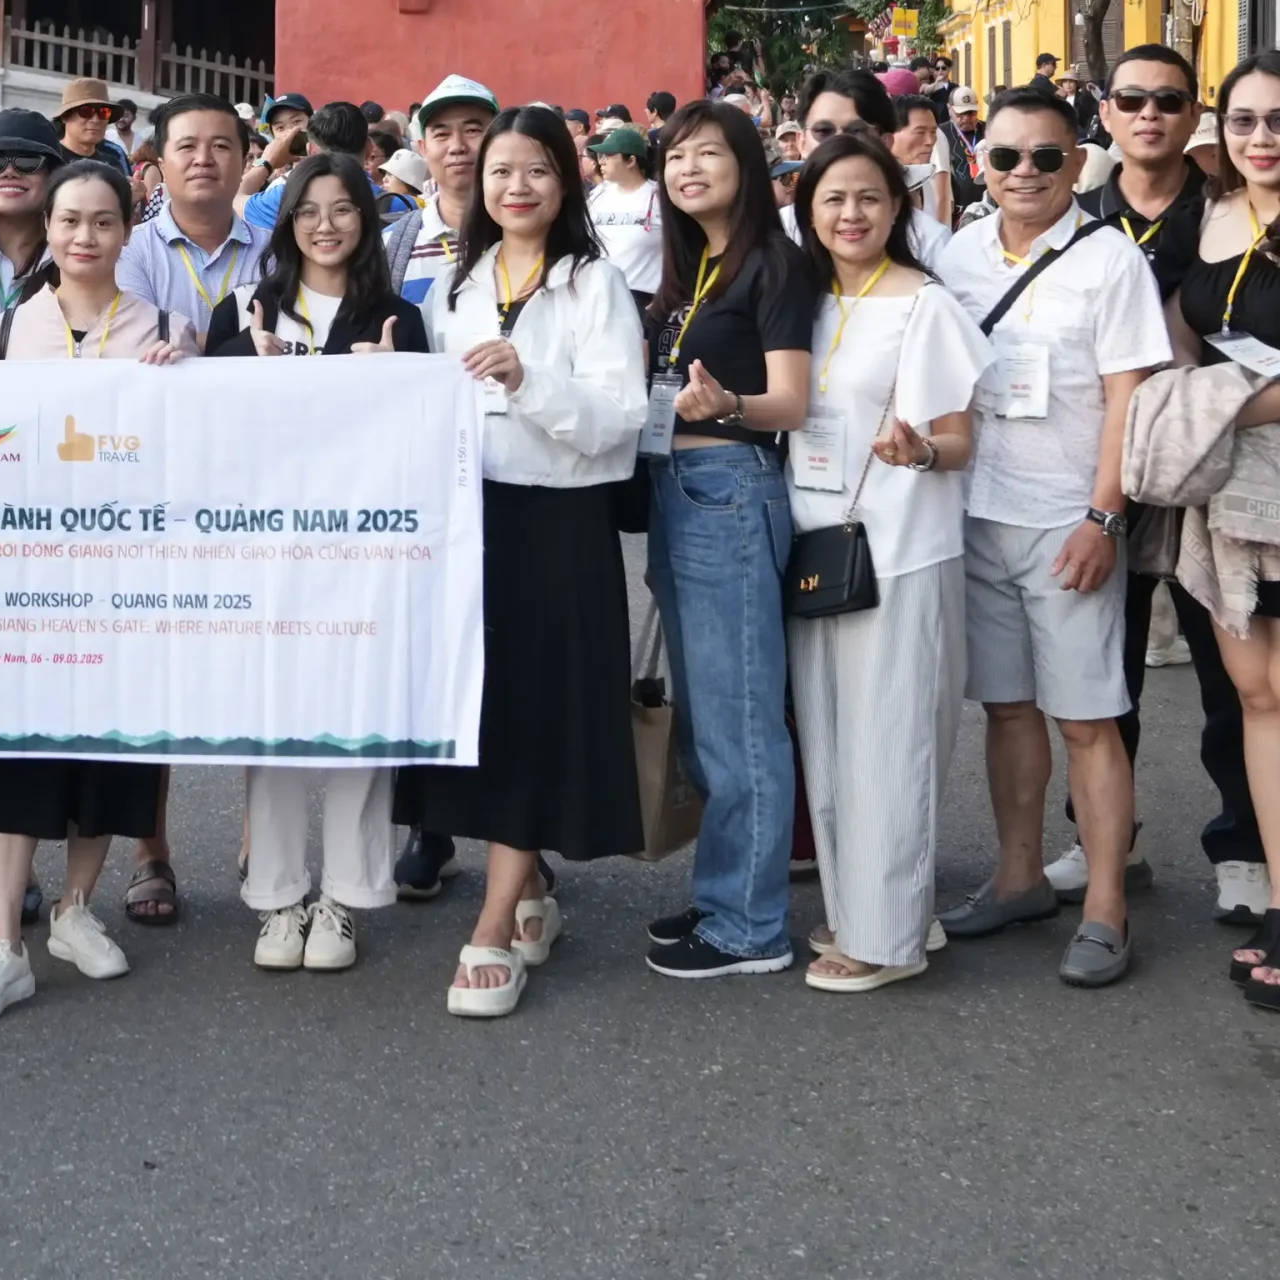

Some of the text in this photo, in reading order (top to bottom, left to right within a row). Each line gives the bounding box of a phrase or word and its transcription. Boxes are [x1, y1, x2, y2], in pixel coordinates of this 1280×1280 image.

[97, 435, 140, 451] FVG
[459, 430, 467, 444] cm
[99, 451, 140, 462] TRAVEL
[457, 447, 467, 464] 150
[60, 500, 131, 532] QUỐC
[139, 501, 171, 532] TẾ
[195, 503, 284, 533] QUẢNG
[293, 509, 348, 532] NAM
[357, 509, 419, 533] 2025
[1246, 500, 1280, 518] CHR
[69, 543, 113, 558] GIANG
[240, 544, 276, 560] GIAO
[5, 592, 94, 608] WORKSHOP
[111, 593, 167, 610] QUANG
[172, 594, 208, 609] NAM
[213, 594, 252, 610] 2025
[155, 620, 204, 635] WHERE
[208, 620, 262, 635] NATURE
[267, 620, 312, 636] MEETS
[316, 621, 378, 636] CULTURE
[4, 653, 27, 664] Nam,
[31, 653, 42, 663] 06
[53, 654, 104, 664] 09.03.2025
